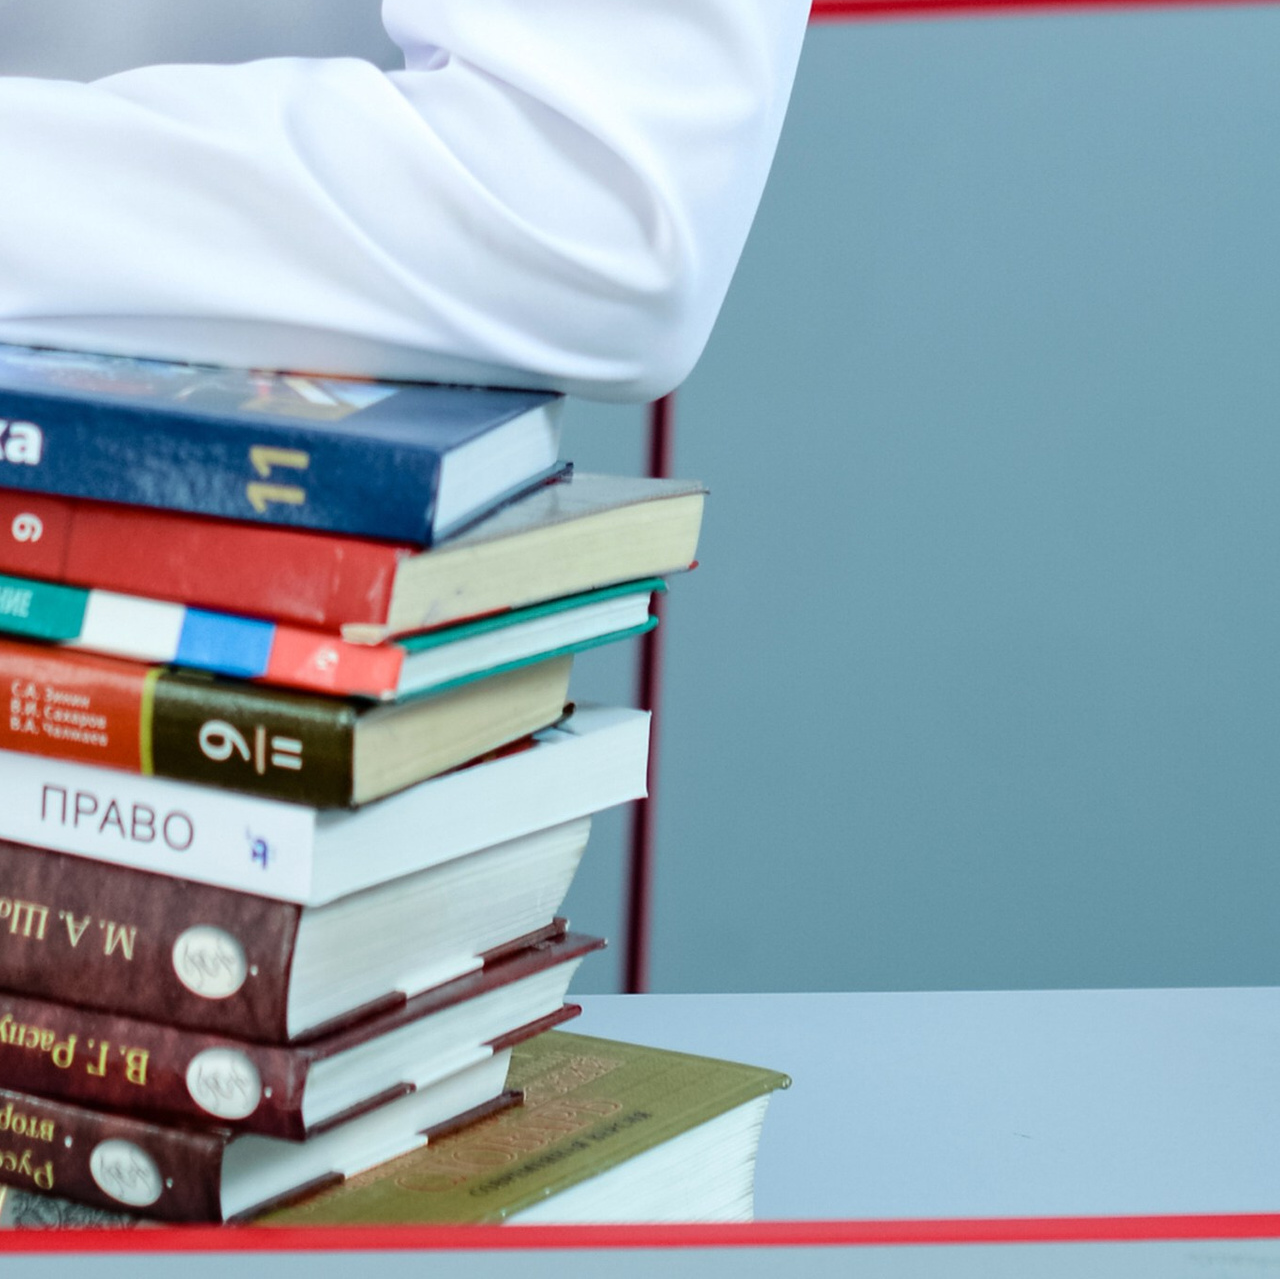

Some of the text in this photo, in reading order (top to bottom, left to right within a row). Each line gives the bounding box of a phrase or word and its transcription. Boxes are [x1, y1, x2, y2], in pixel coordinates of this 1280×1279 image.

[246, 445, 309, 513] 11
[11, 512, 43, 543] 9
[199, 720, 250, 761] 9
[41, 784, 194, 851] ПРАВО
[59, 911, 91, 947] А.
[99, 921, 137, 960] М.
[87, 1038, 109, 1076] Г.
[119, 1045, 149, 1085] В.
